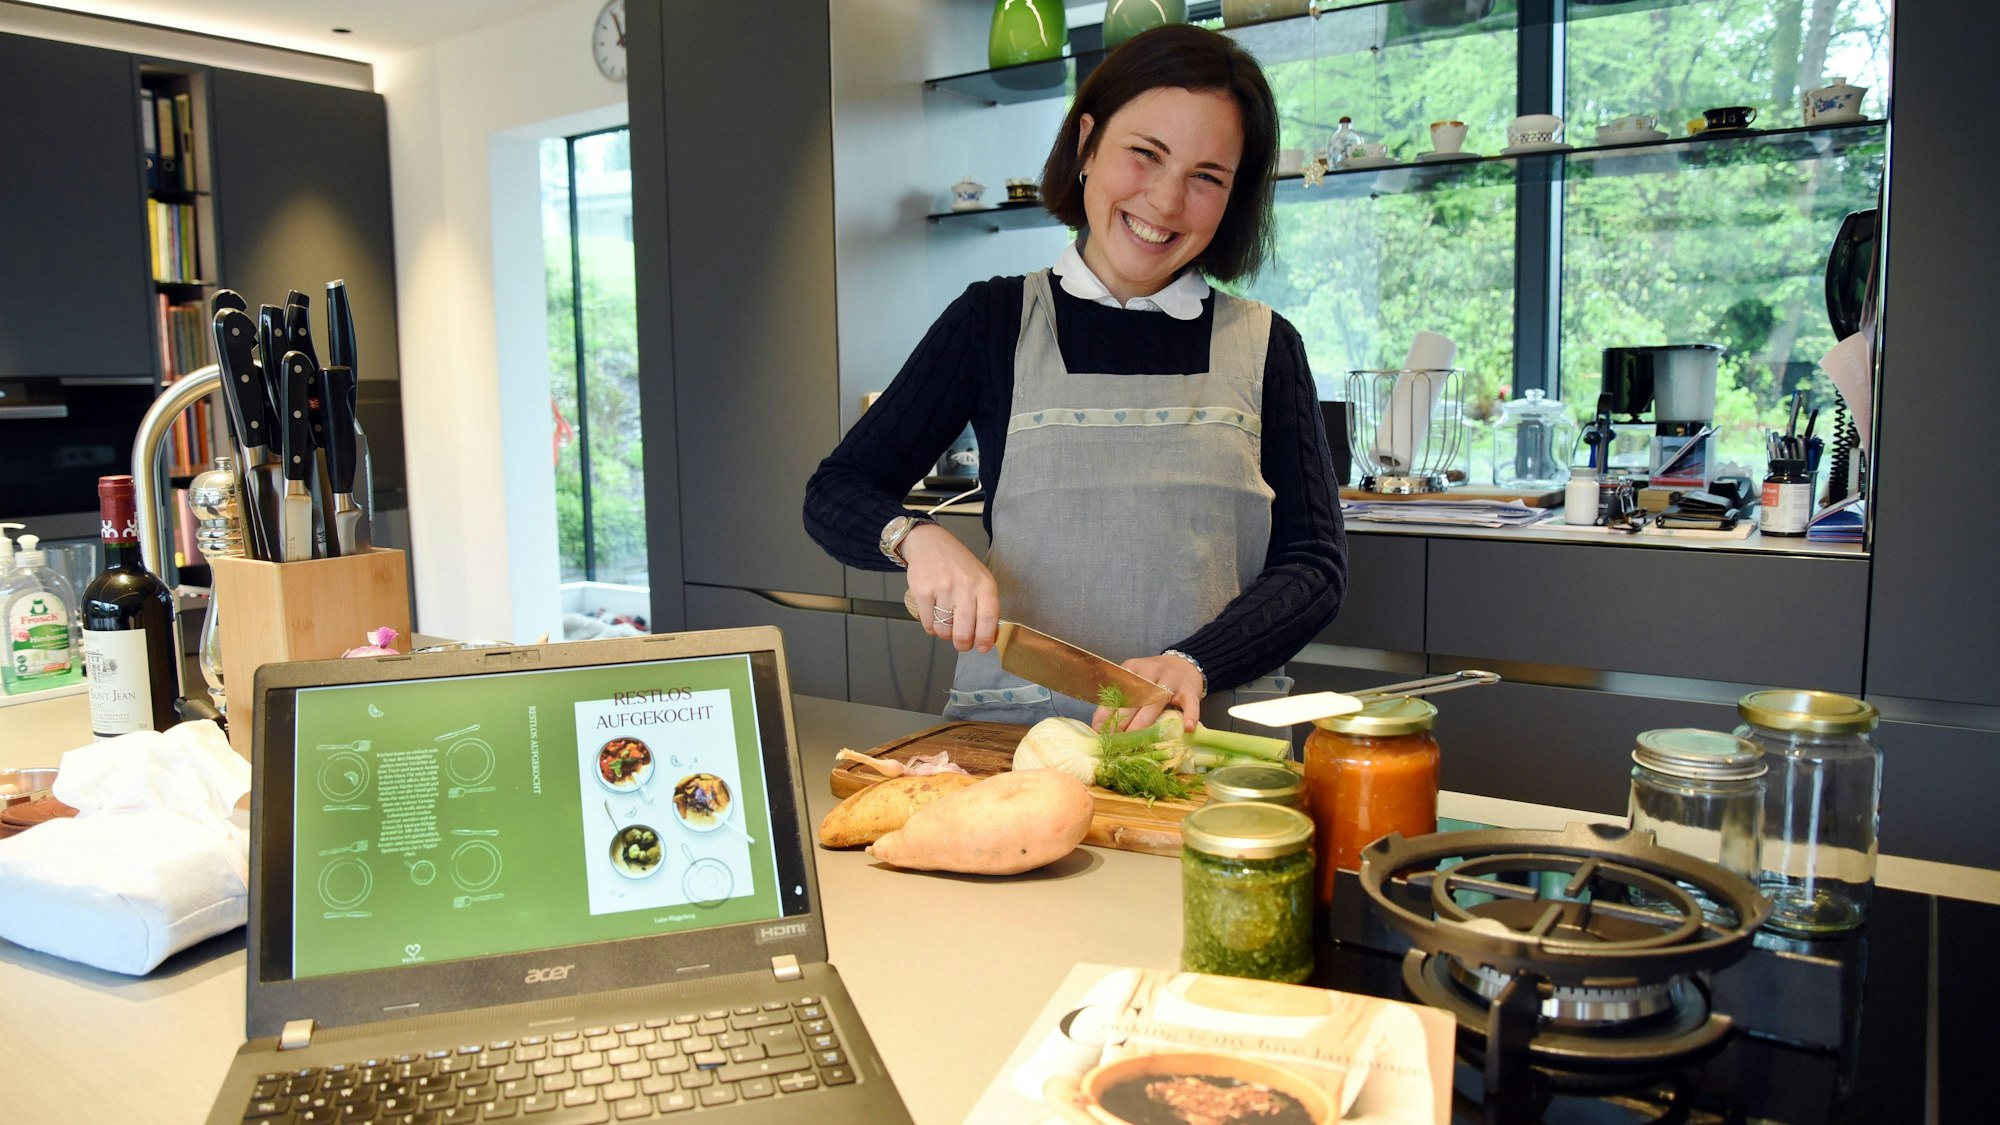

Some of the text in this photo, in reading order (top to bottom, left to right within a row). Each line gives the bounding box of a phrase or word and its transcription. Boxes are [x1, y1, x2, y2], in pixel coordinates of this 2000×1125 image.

[20, 613, 58, 624] Frosch
[614, 686, 692, 706] RESTLOS
[596, 705, 714, 729] AUFGEKOCHT
[528, 705, 541, 795] RESTLOS AUFGEKOCHT
[760, 923, 807, 938] HDMI
[524, 964, 575, 984] acer
